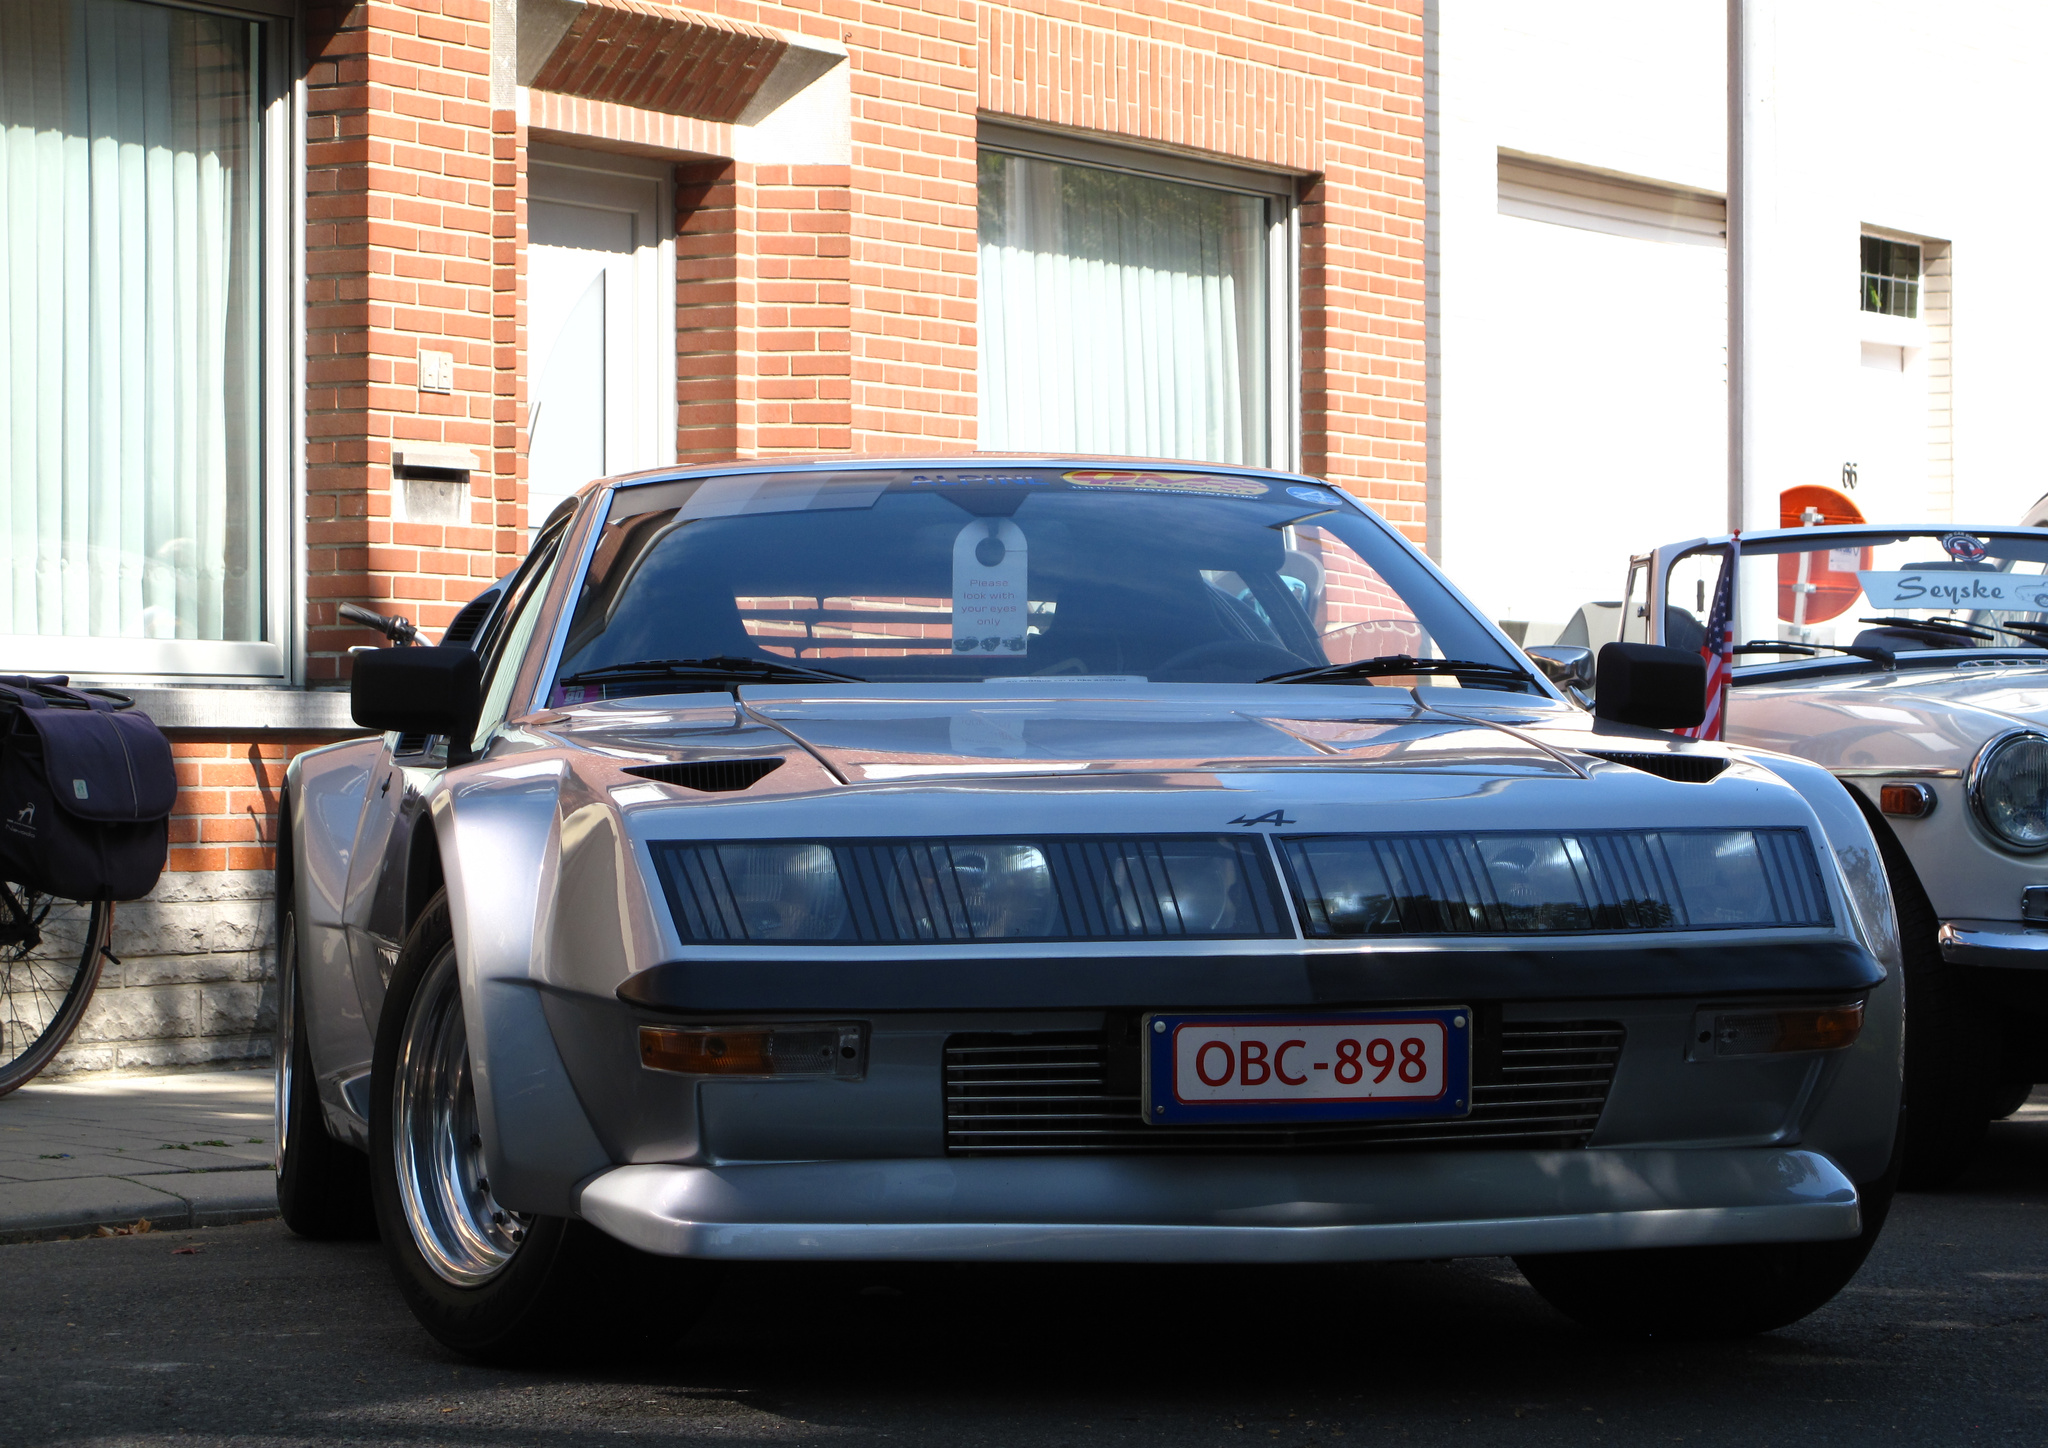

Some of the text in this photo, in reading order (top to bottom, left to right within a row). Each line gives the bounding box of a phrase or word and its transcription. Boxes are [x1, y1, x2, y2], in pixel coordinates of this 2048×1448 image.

[910, 474, 1050, 487] ALPINE
[1842, 461, 1858, 490] 66
[969, 579, 1009, 587] Please
[963, 592, 1015, 600] look with
[1894, 576, 2005, 605] Seyske
[977, 618, 1001, 626] only
[1195, 1037, 1427, 1087] OBC-898
